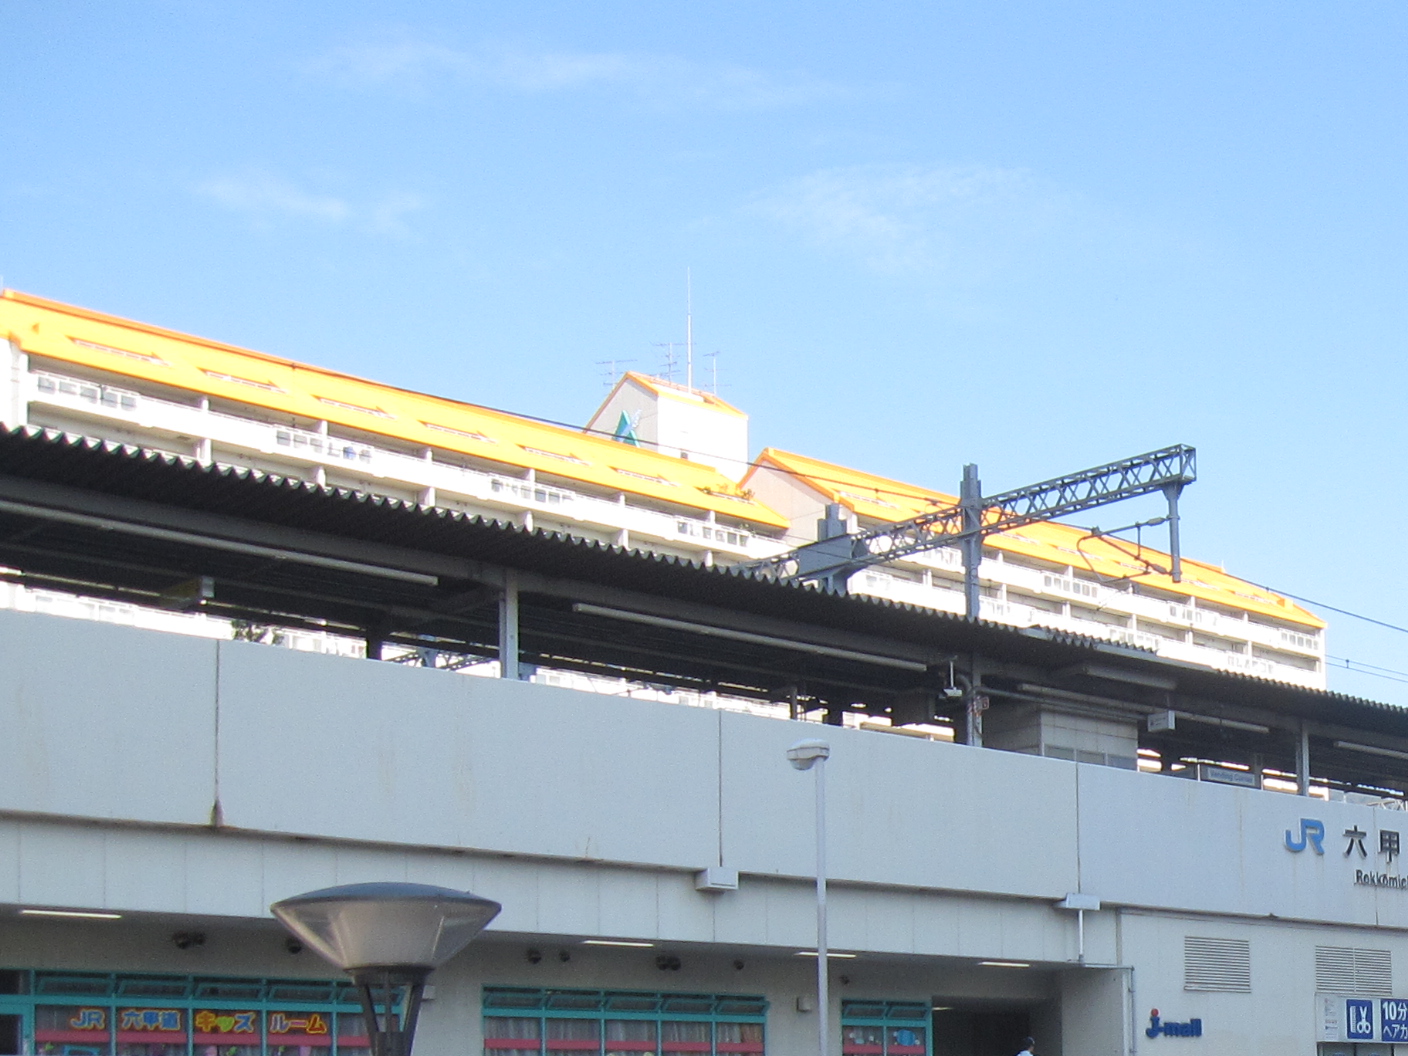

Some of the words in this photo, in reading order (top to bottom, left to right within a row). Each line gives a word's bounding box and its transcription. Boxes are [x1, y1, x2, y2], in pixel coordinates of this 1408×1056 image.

[1283, 818, 1325, 856] JR
[70, 1007, 106, 1031] JR
[120, 1008, 182, 1032] 六甲道
[194, 1008, 257, 1034] キッズ
[268, 1011, 329, 1036] ルーム
